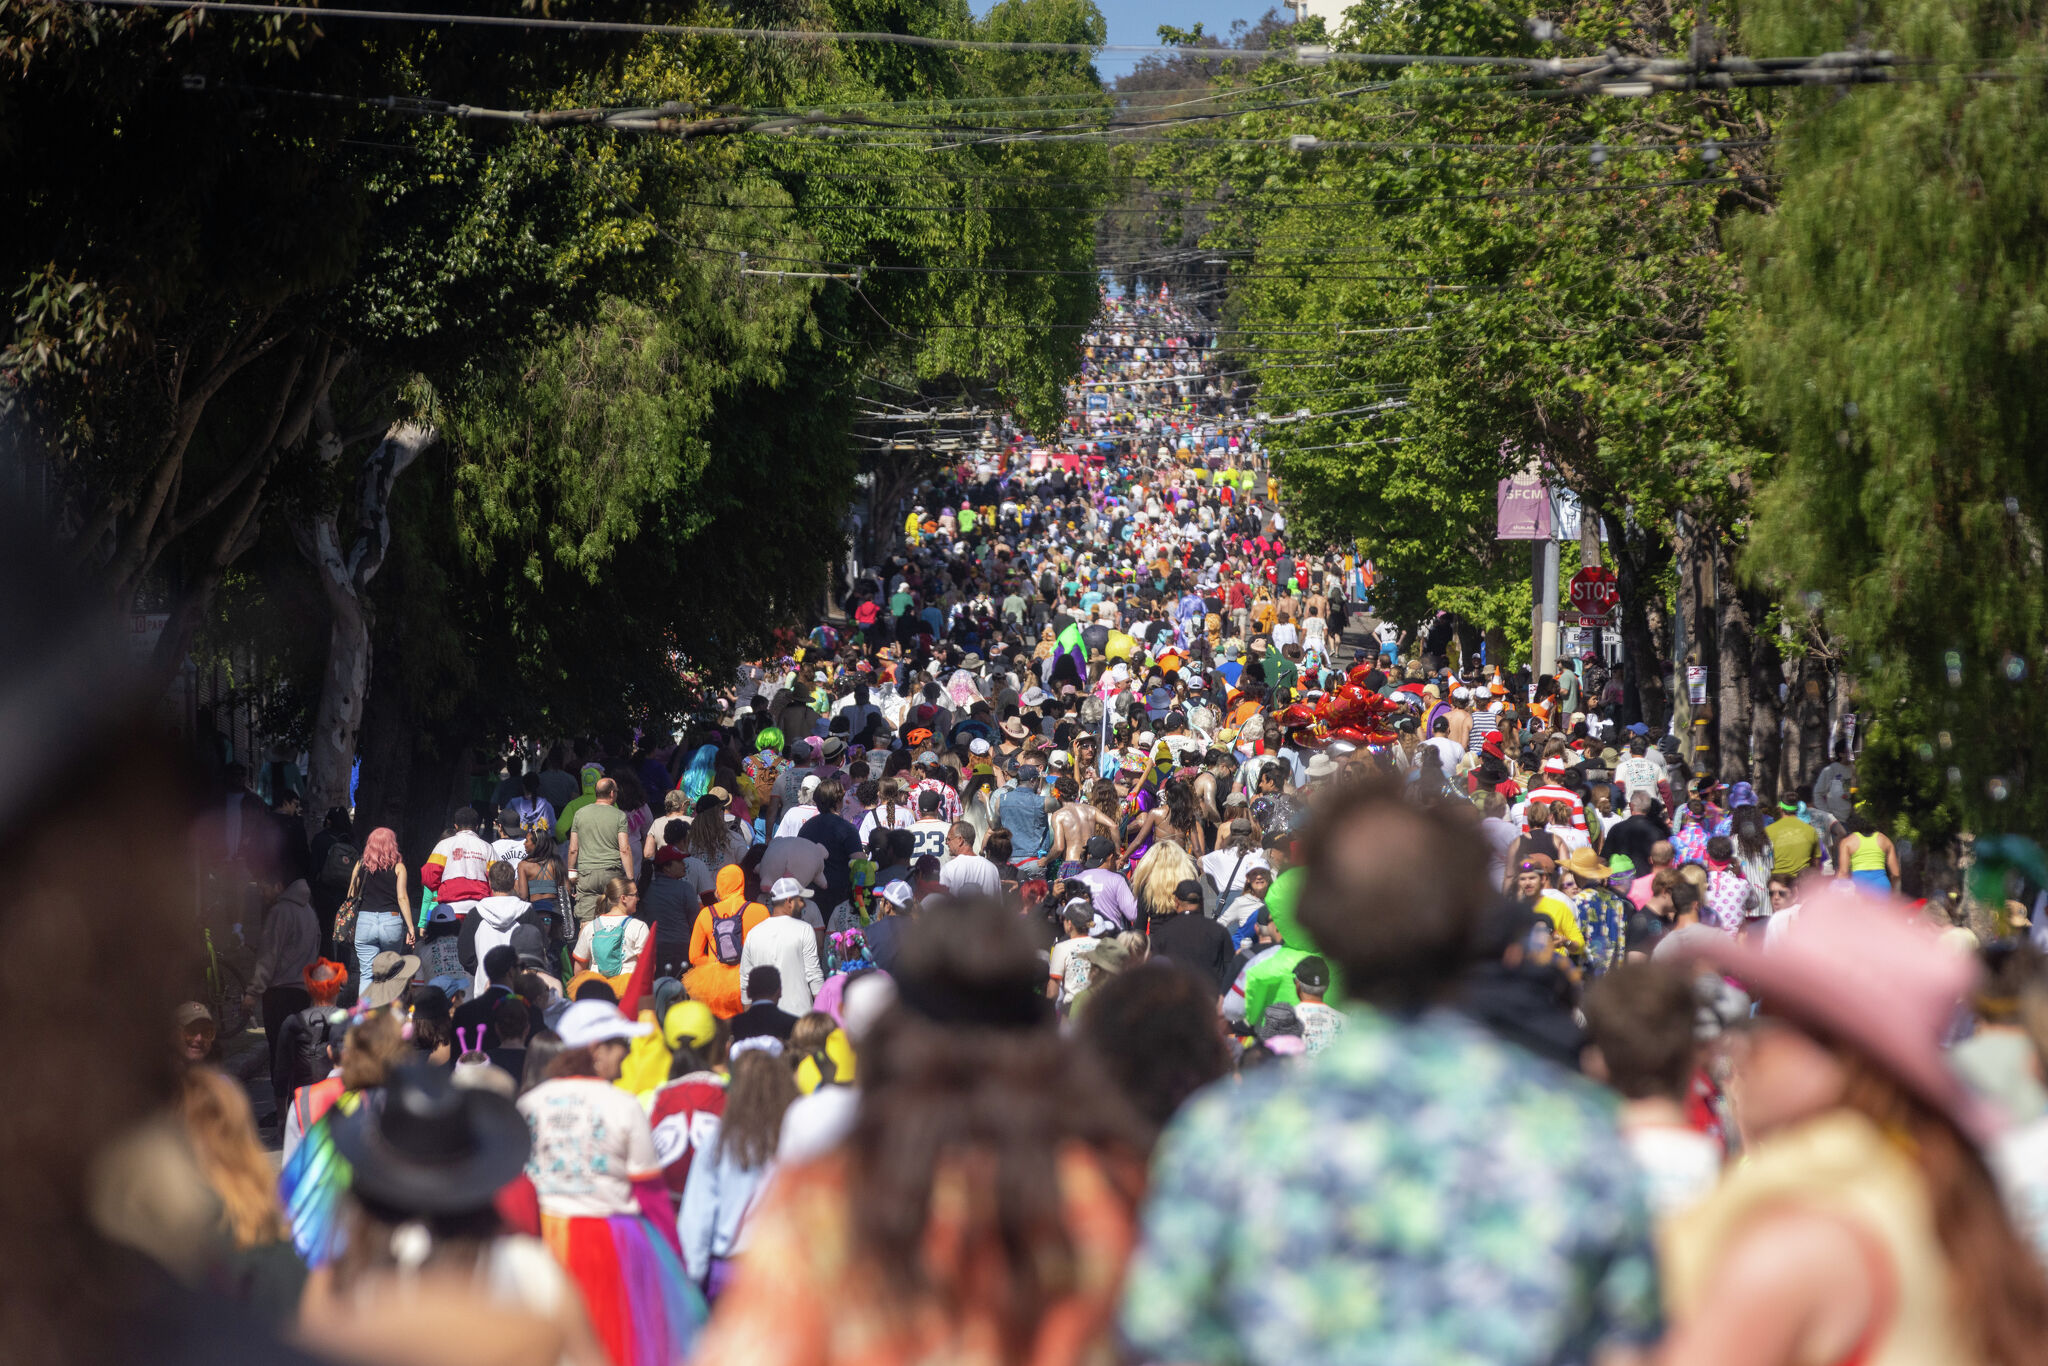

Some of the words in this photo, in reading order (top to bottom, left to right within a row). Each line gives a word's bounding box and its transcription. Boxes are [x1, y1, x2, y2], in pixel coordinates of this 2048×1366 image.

[1507, 489, 1543, 500] SFCM
[1573, 581, 1616, 600] STOP
[911, 831, 944, 858] 23
